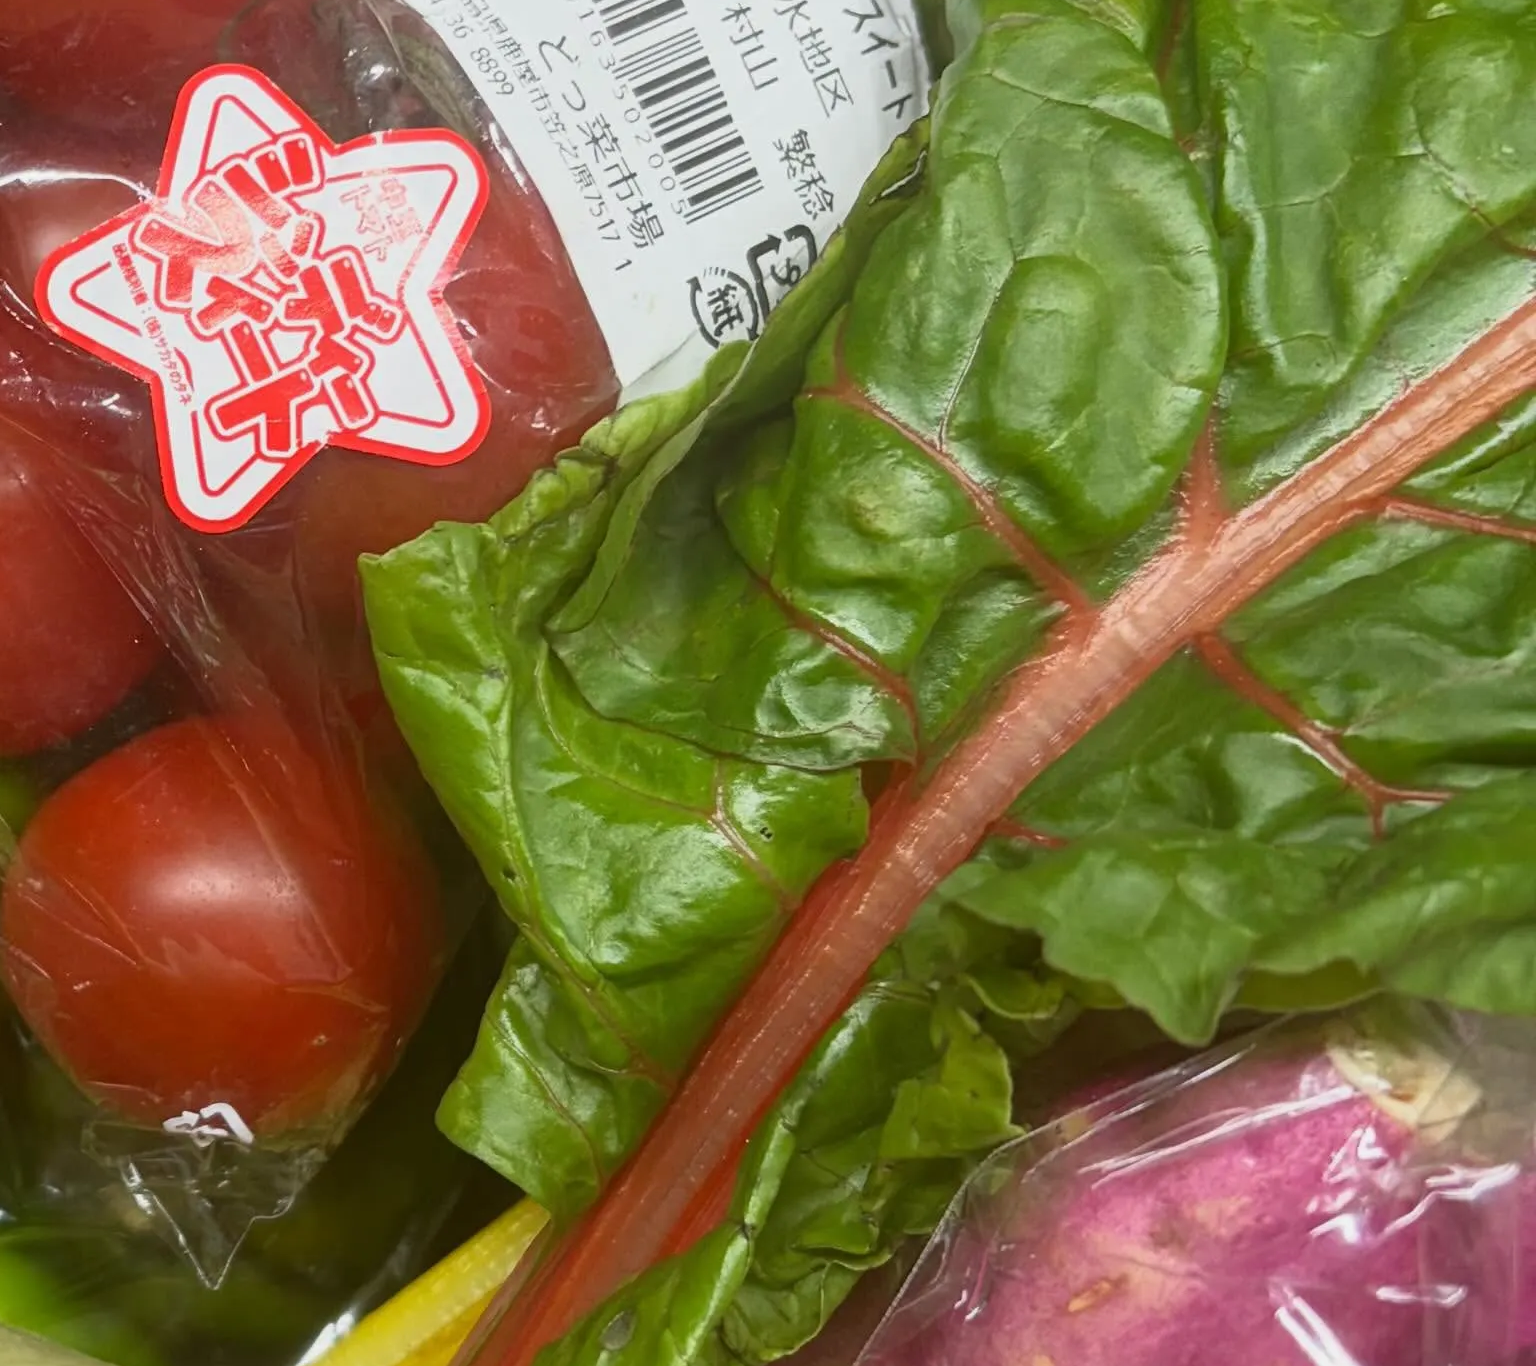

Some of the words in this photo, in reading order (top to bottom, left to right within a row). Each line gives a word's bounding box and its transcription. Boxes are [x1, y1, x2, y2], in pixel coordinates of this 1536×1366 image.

[721, 0, 780, 91] 村山
[537, 34, 665, 251] どっ菜市場
[339, 184, 395, 264] トマト
[136, 179, 316, 453] スイート
[706, 281, 742, 337] 紙
